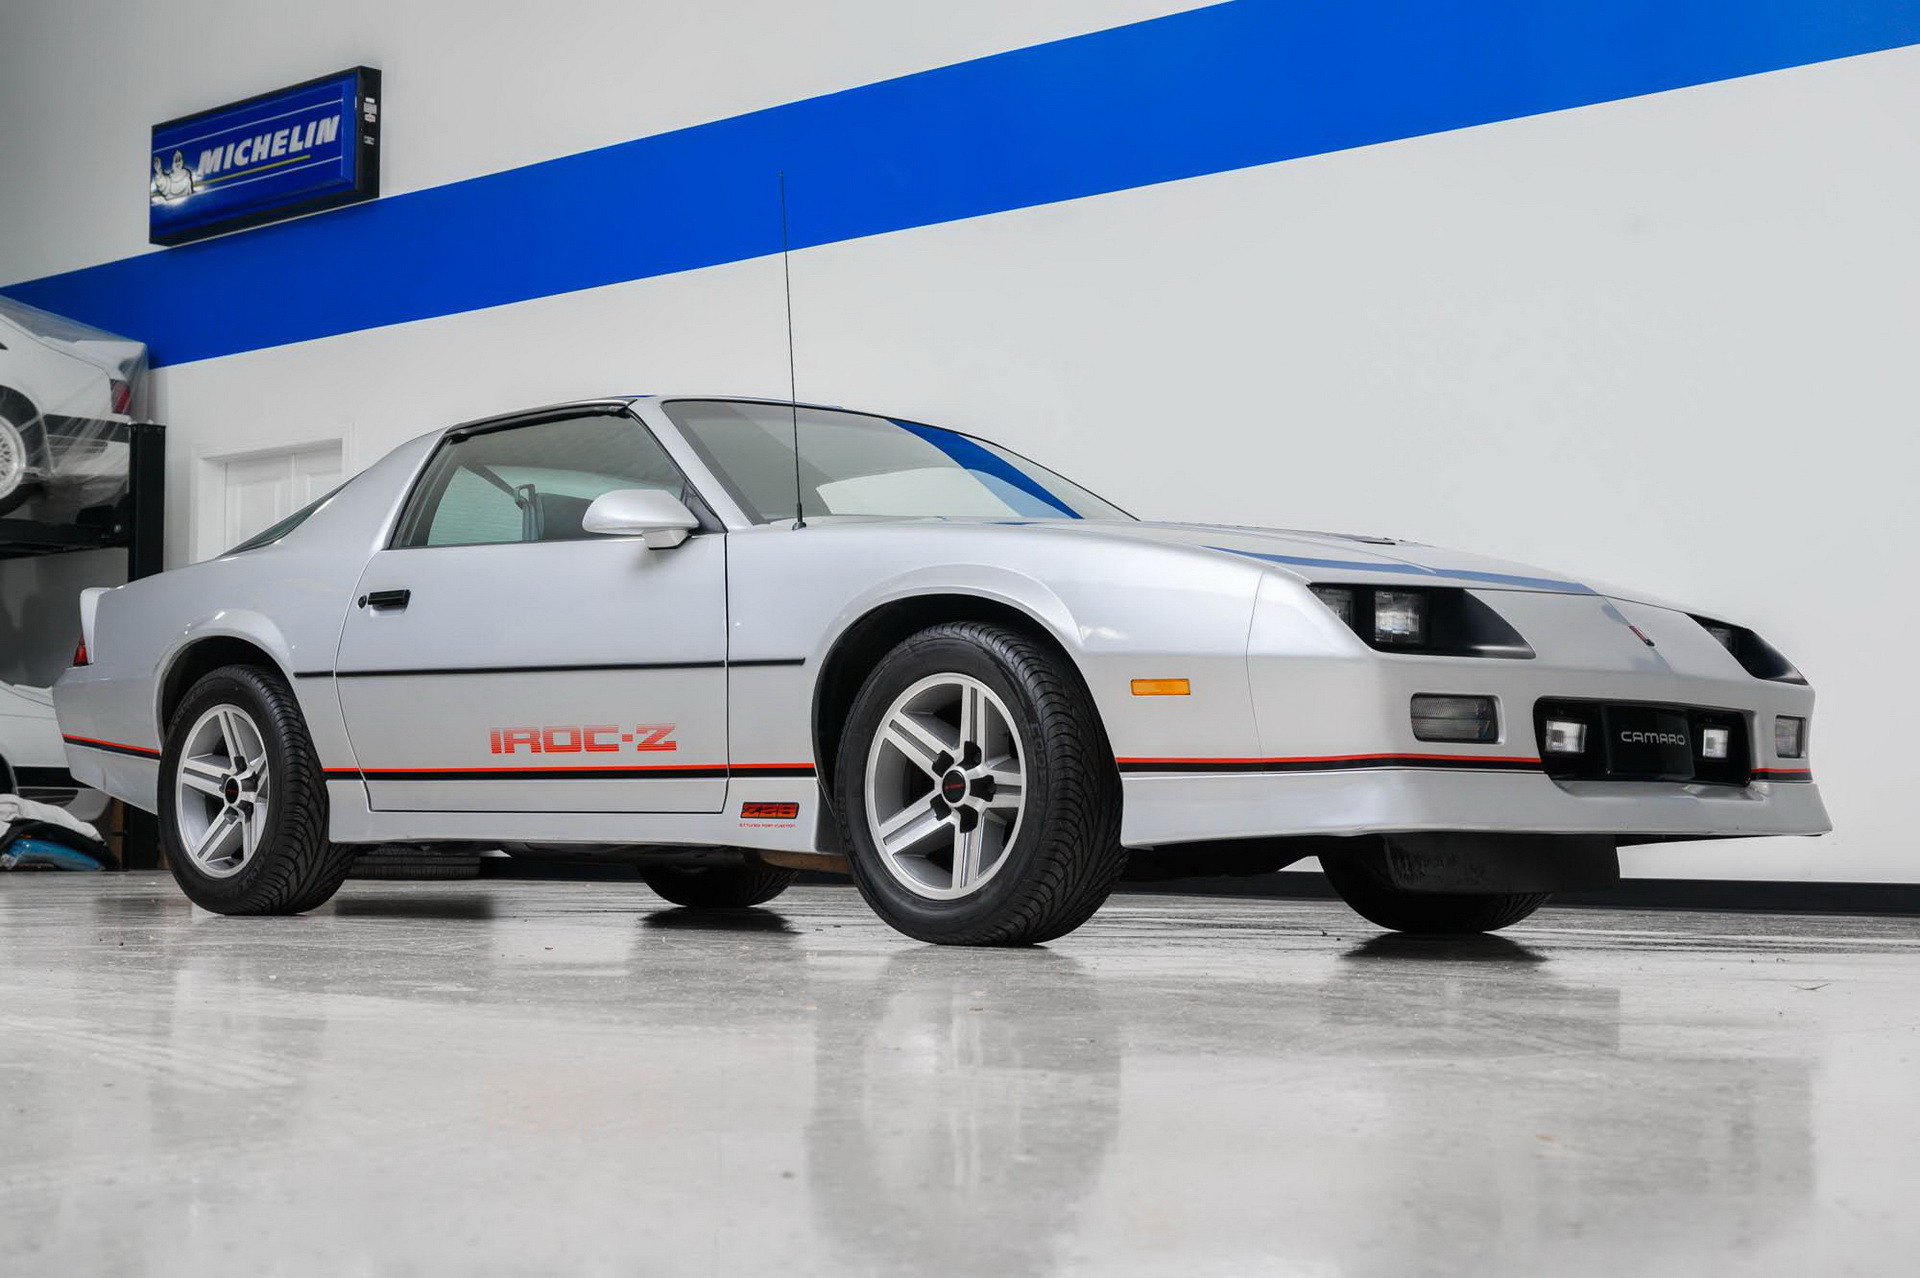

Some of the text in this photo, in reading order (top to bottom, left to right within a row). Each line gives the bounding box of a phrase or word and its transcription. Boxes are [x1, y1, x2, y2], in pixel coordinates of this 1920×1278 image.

[198, 115, 341, 175] MICHELIN
[490, 724, 677, 753] IROC-Z
[1621, 731, 1686, 745] CAMARO
